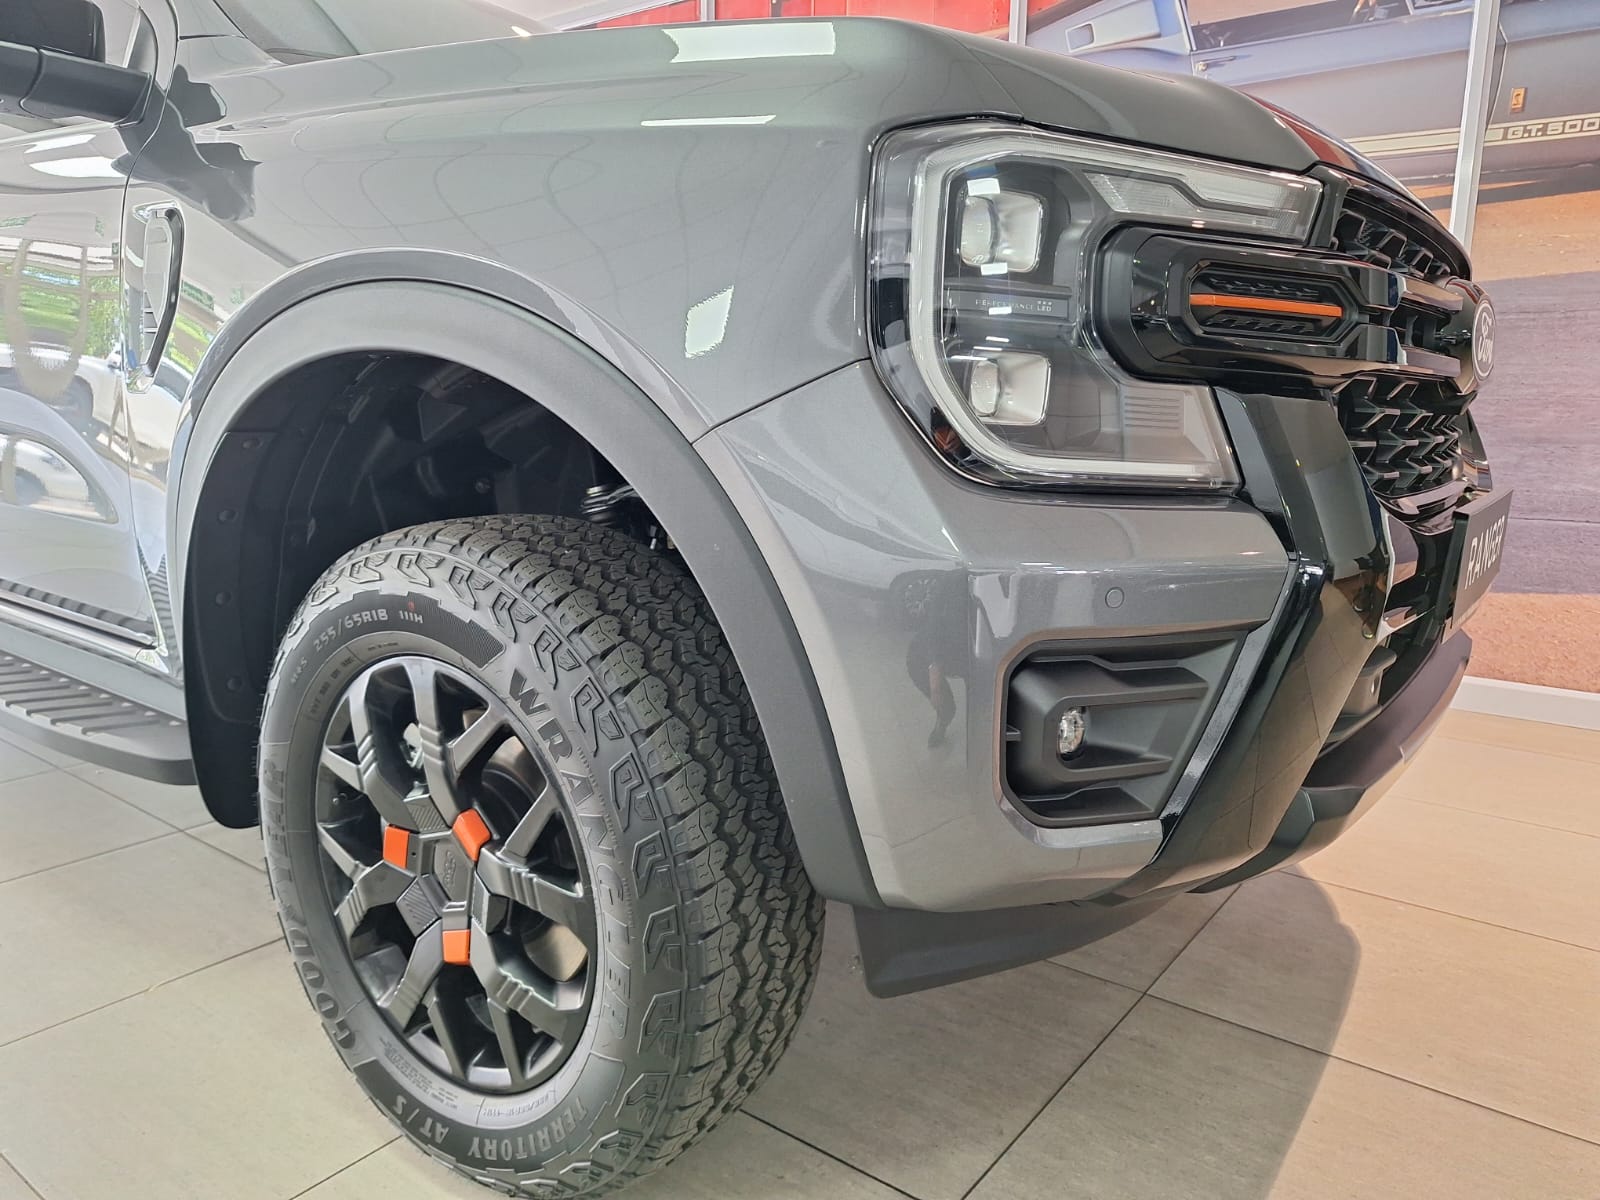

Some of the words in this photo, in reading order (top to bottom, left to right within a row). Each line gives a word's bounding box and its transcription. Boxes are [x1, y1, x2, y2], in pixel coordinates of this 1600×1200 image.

[1477, 311, 1494, 365] Ford
[1464, 515, 1505, 590] RANGER
[313, 608, 389, 652] 255/65R18
[508, 667, 631, 1041] WRANGLER
[467, 1099, 588, 1161] TERRITORY
